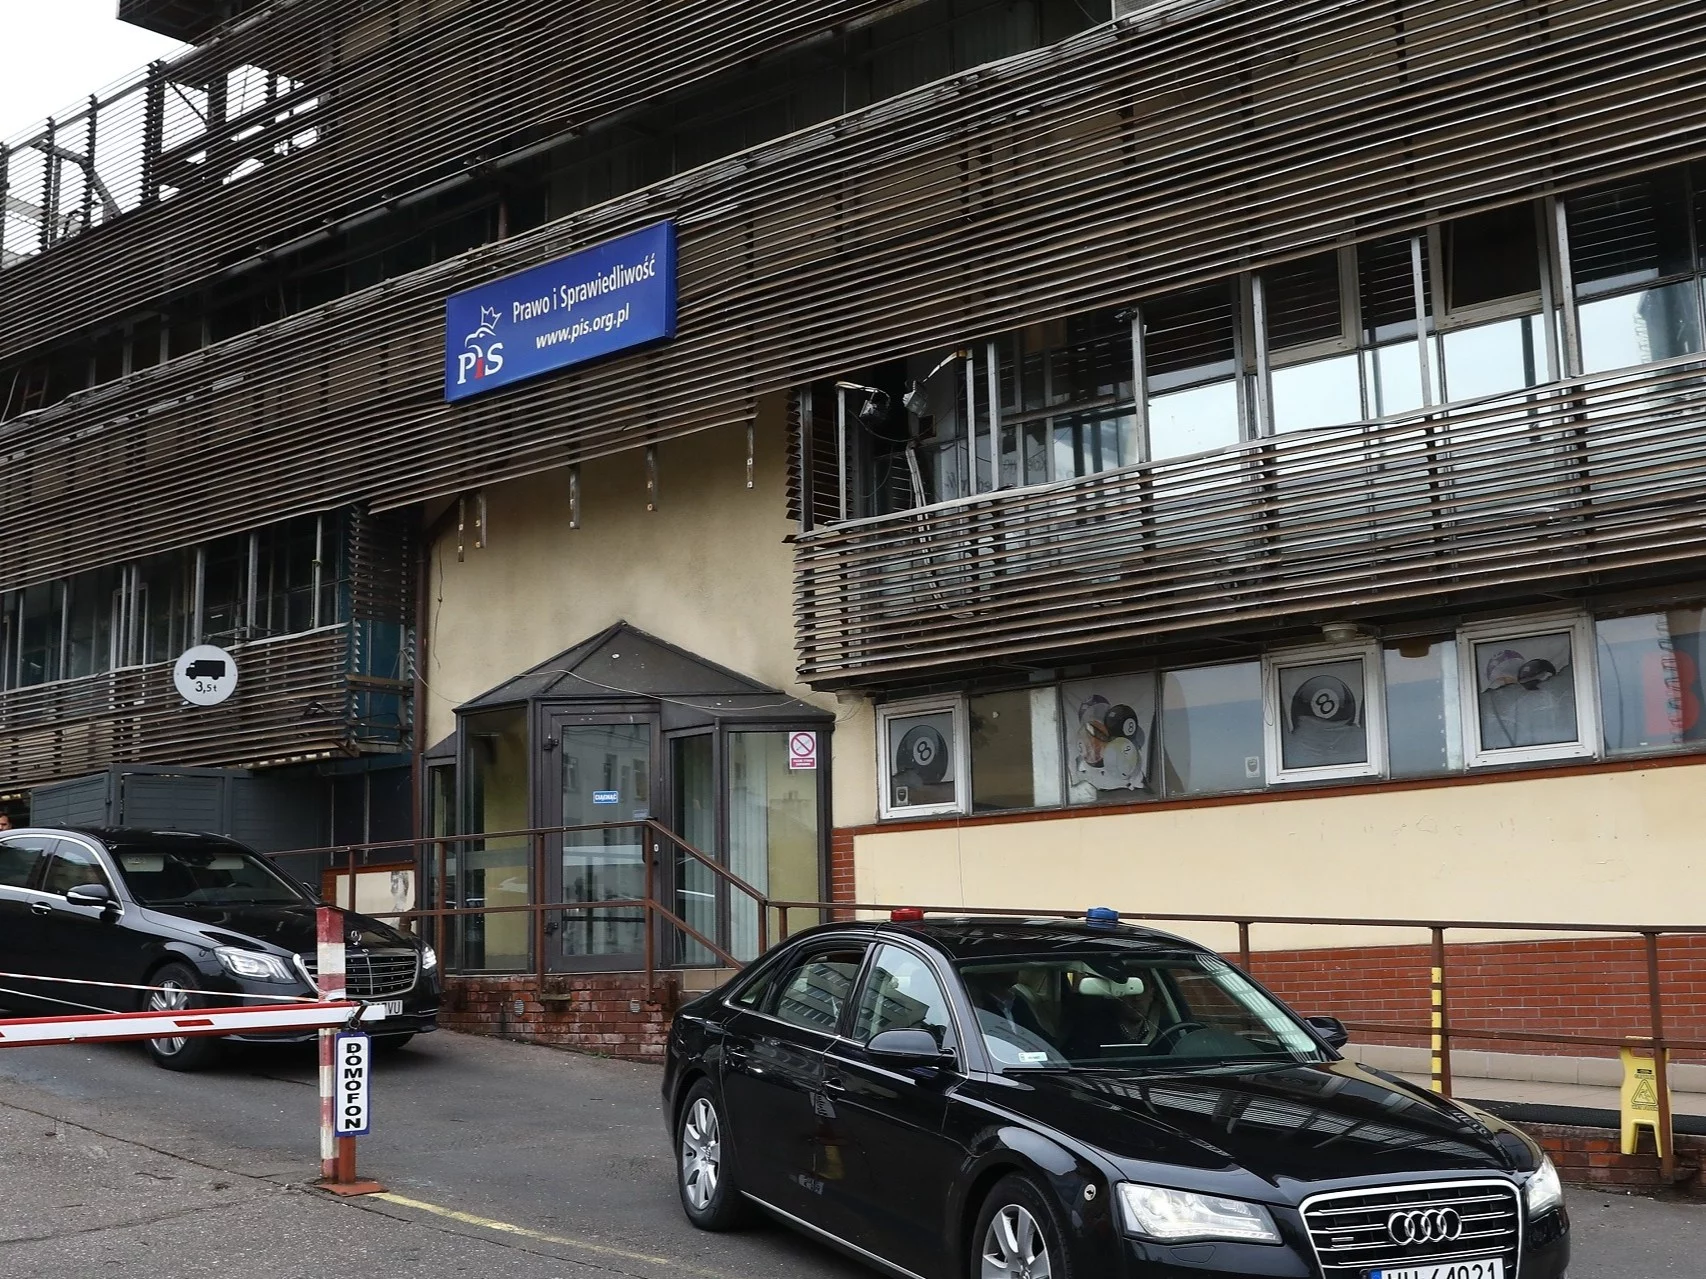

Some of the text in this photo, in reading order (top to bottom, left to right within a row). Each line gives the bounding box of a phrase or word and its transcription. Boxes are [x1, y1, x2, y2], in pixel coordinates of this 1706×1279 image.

[512, 252, 656, 323] Prawo i Sprawiedliwość
[535, 302, 630, 350] www.pis.org.pl
[456, 342, 504, 385] PiS
[916, 739, 933, 762] 8
[344, 1042, 363, 1129] DOMOFON
